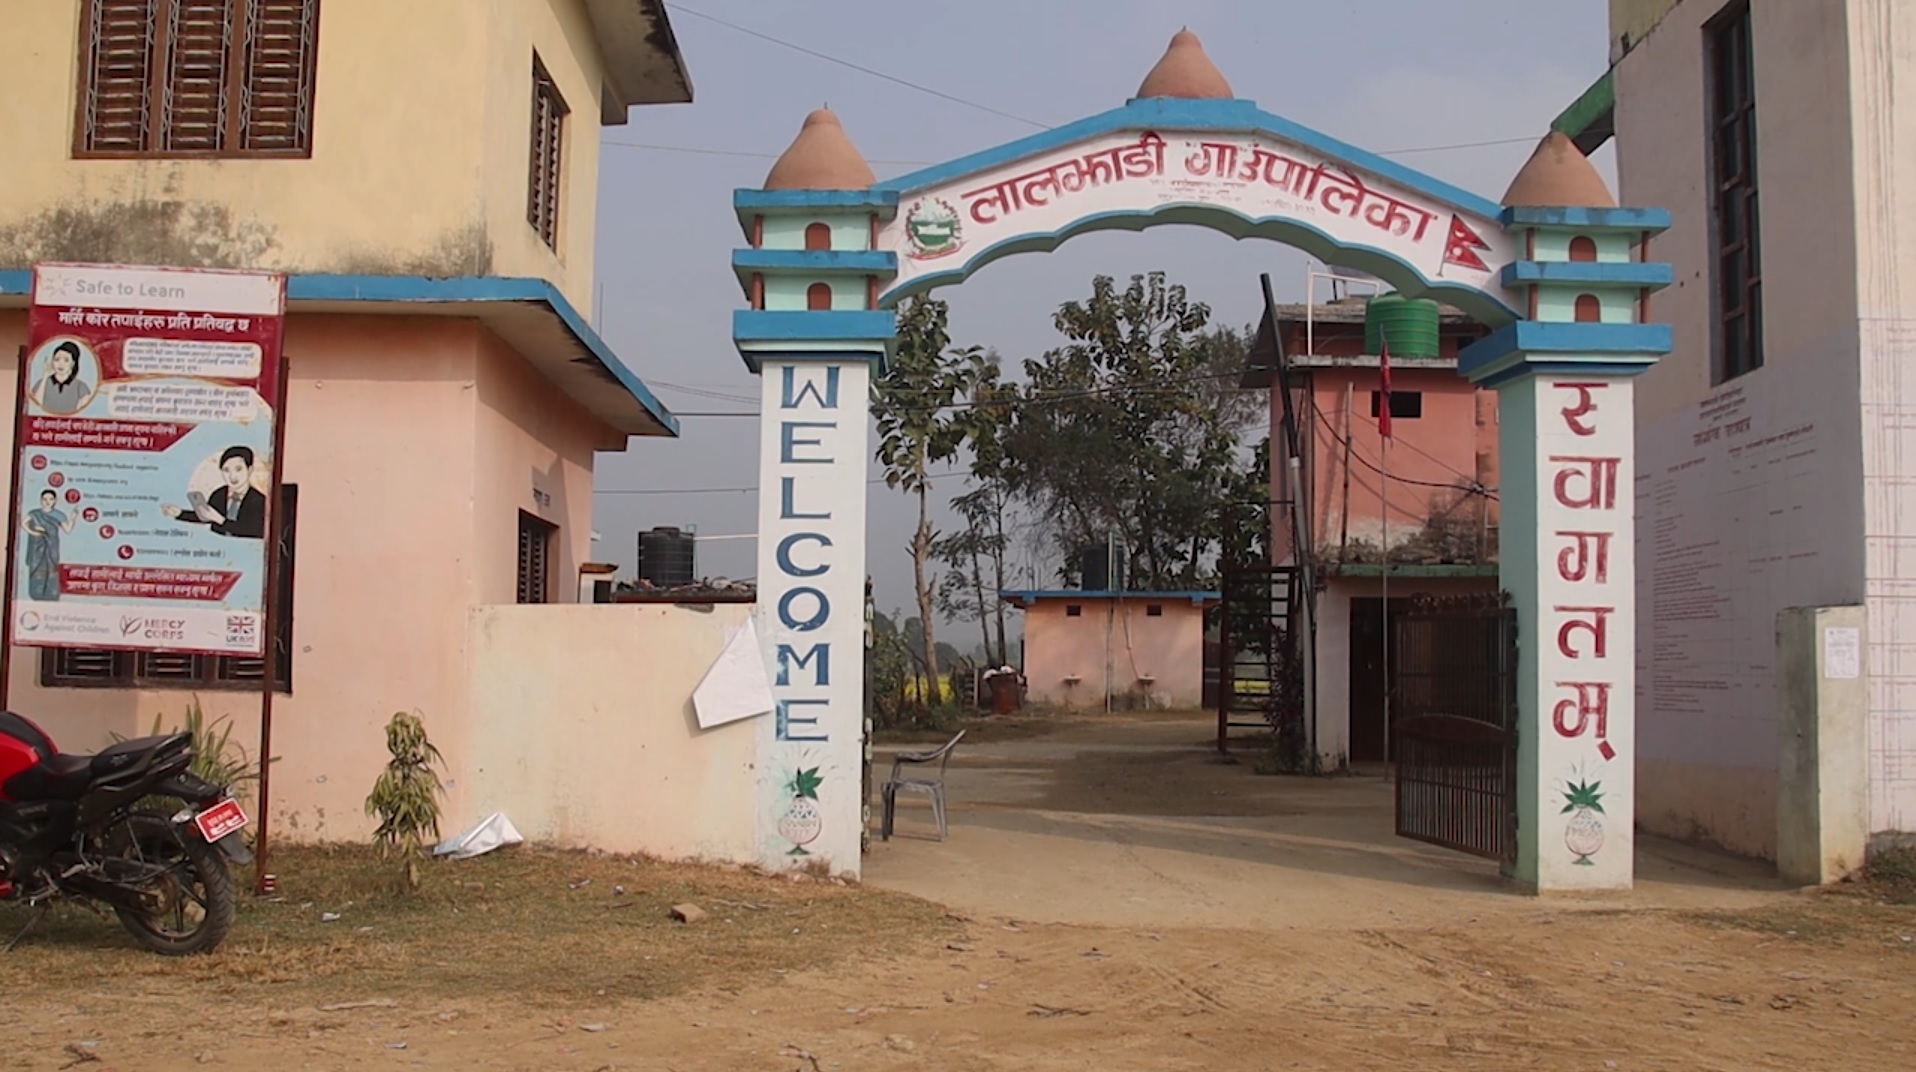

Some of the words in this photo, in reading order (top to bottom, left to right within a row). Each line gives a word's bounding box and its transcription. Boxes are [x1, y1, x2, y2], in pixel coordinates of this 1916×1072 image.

[76, 279, 113, 296] Safe
[118, 282, 134, 296] to
[139, 282, 186, 299] Learn
[774, 365, 841, 742] WELCOME
[144, 618, 186, 629] MERCY
[144, 629, 185, 640] CORPS
